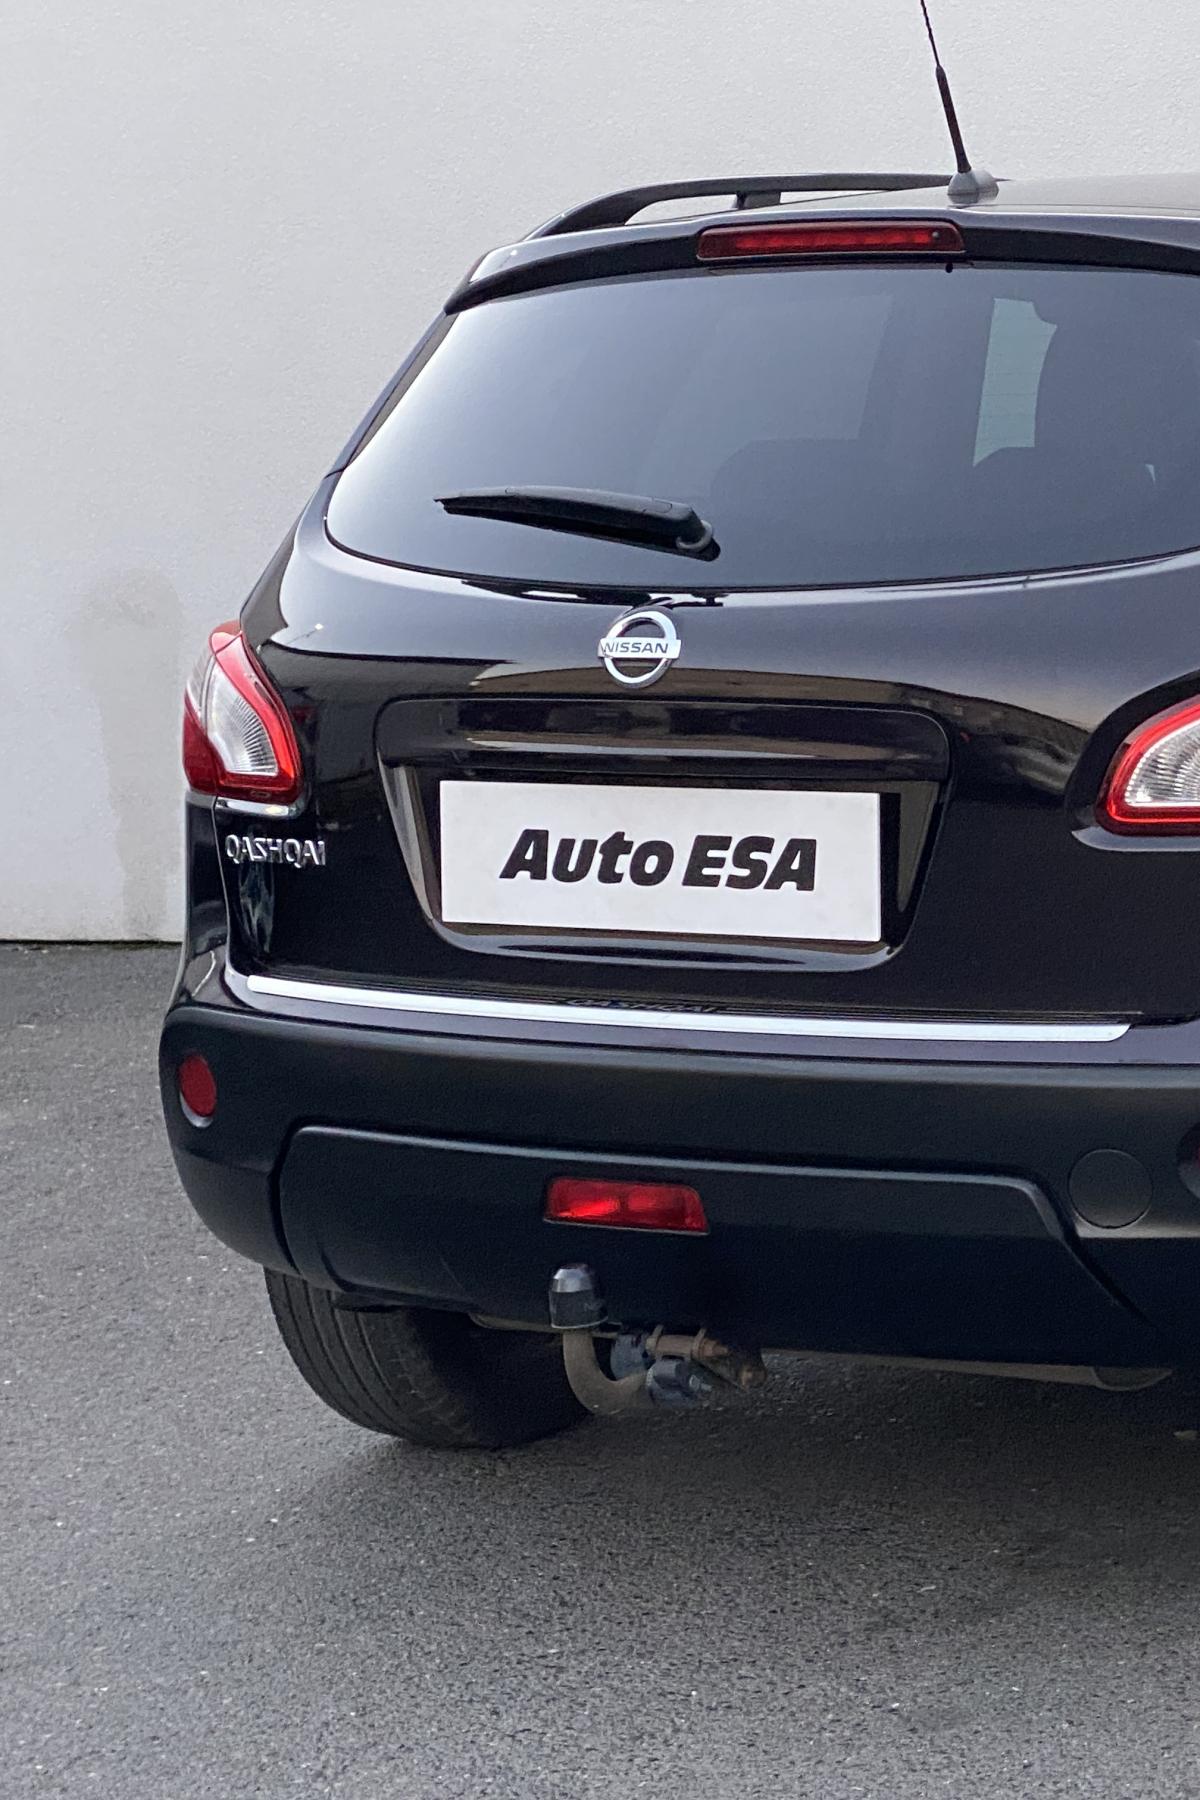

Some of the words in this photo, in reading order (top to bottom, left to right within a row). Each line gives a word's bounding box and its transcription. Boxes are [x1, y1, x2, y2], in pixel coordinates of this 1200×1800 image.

[603, 642, 669, 654] NISSAN
[225, 834, 326, 868] QASHQAI
[499, 828, 675, 887] Auto
[681, 834, 817, 892] ESA
